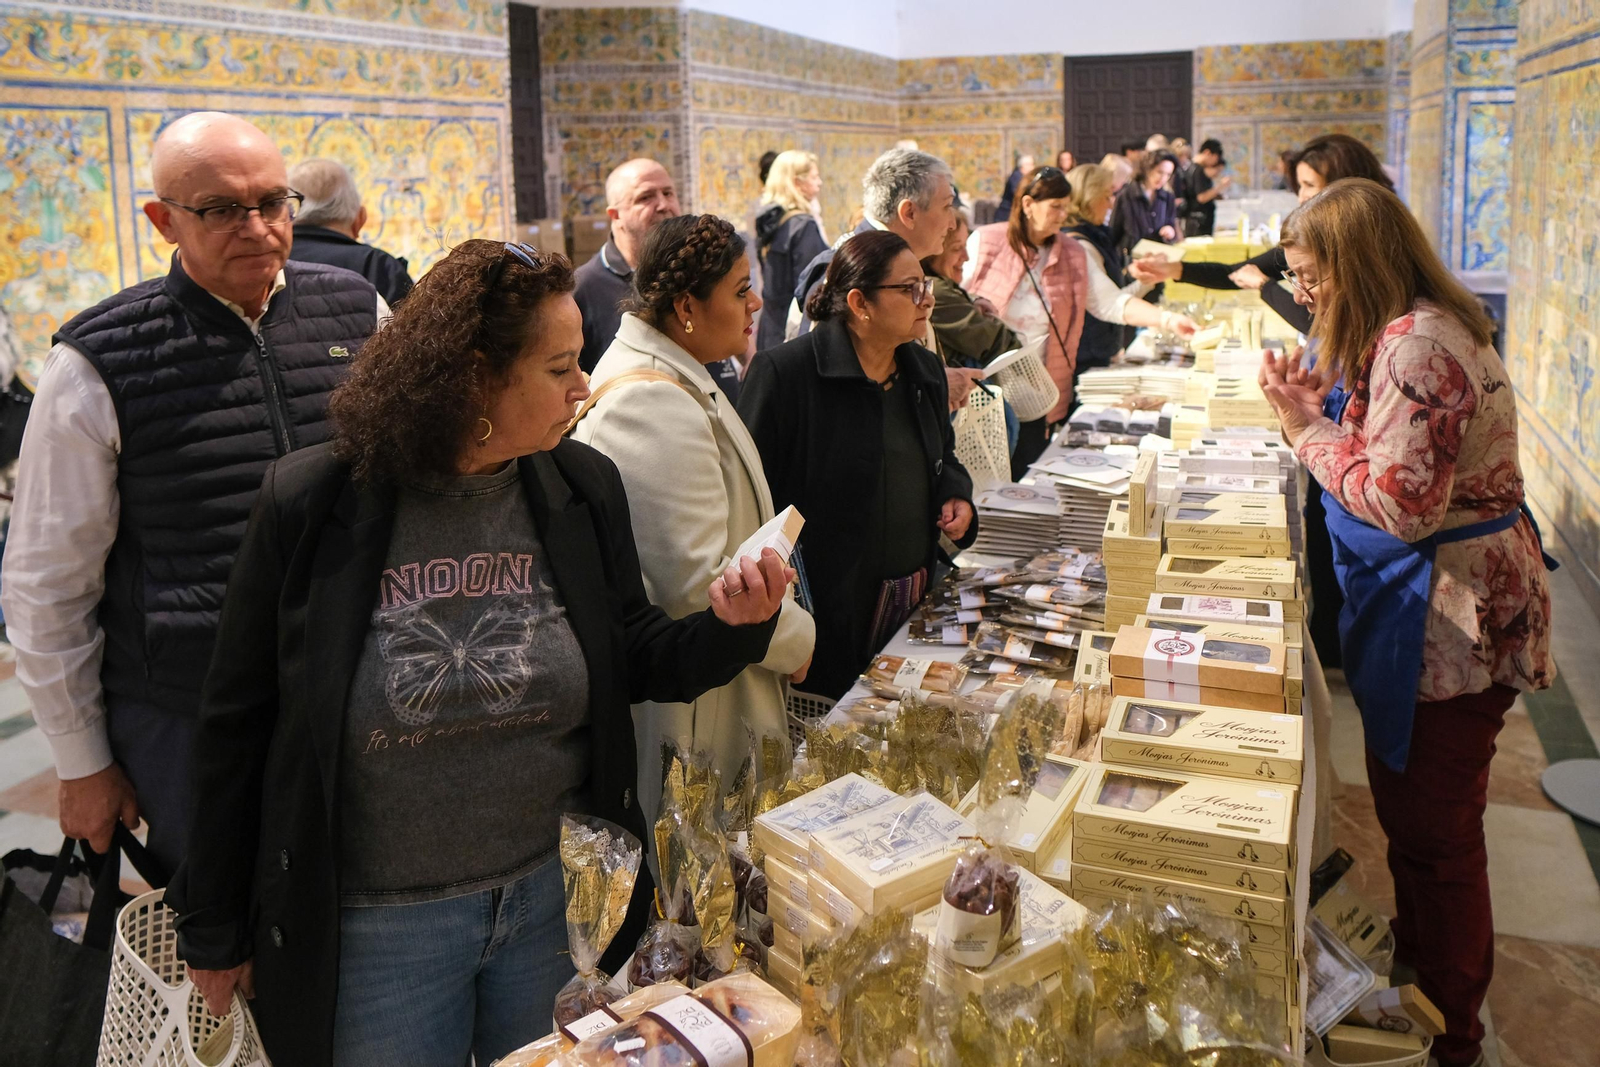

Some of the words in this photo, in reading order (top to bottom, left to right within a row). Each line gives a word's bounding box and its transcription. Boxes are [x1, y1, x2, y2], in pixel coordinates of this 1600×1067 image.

[380, 552, 533, 611] NOON
[1199, 721, 1281, 735] Monjas
[1128, 746, 1173, 761] Monjas
[1180, 795, 1268, 812] Monjas
[1101, 823, 1150, 839] Monjas
[1151, 830, 1210, 848] Jerónimas
[1101, 850, 1148, 866] Monjas
[1150, 857, 1208, 876] Jerónimas
[1099, 877, 1146, 893] Monja
